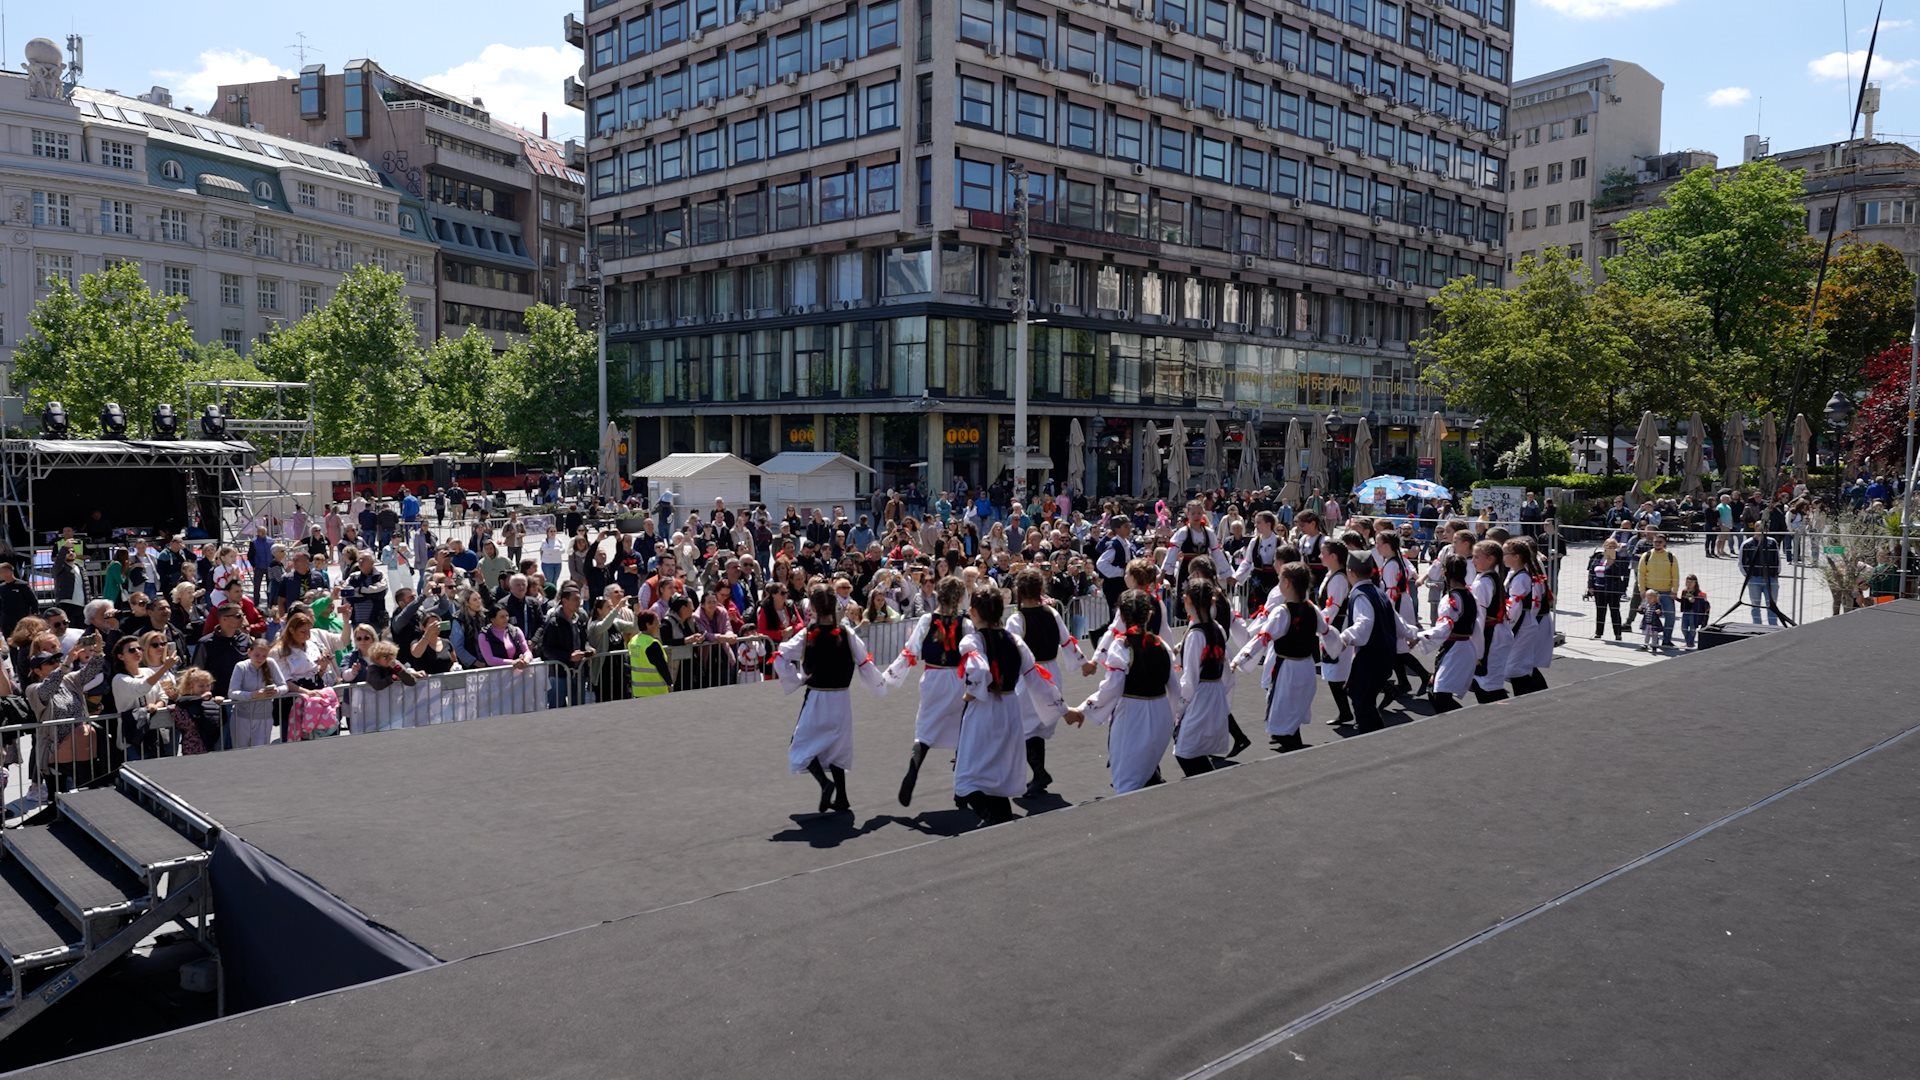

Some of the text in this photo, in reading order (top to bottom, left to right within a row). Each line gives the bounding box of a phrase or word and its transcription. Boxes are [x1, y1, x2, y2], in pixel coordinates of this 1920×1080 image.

[1311, 378, 1361, 394] БЕОГРАДА
[1369, 380, 1412, 397] CULTURAL
[948, 429, 978, 442] TRG
